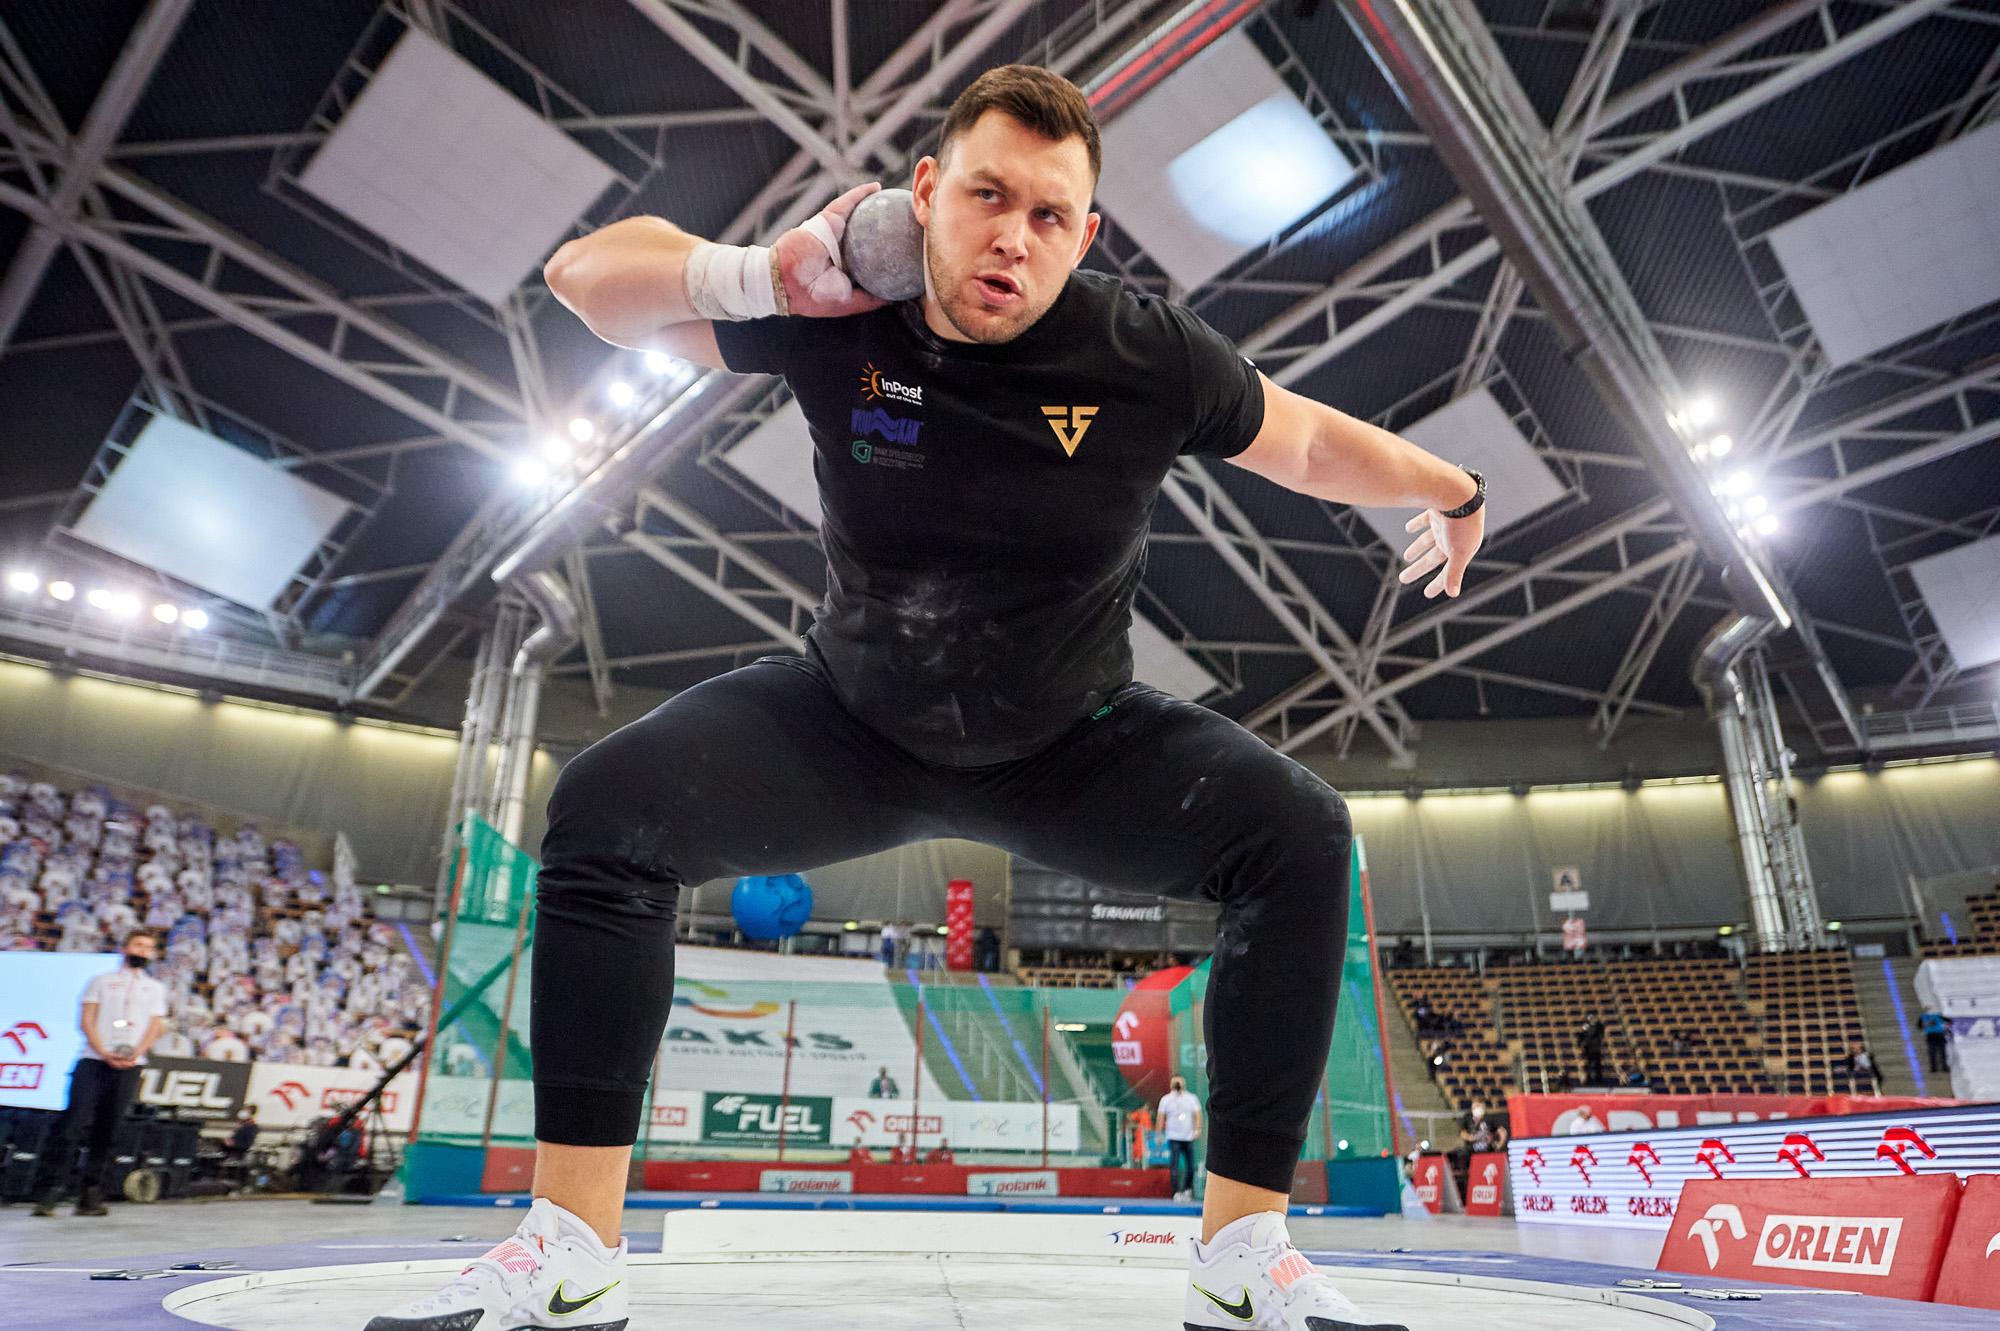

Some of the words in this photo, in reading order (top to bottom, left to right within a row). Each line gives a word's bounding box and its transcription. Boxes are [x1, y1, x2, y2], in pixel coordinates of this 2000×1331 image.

[881, 377, 923, 400] InPost
[738, 1103, 822, 1133] FUEL
[789, 1178, 842, 1192] polanik
[995, 1177, 1047, 1195] polanik
[1523, 1194, 1555, 1212] ORLEN
[1570, 1195, 1609, 1215] ORLEN
[1124, 1230, 1176, 1246] polanik
[1765, 1223, 1890, 1265] ORLEN
